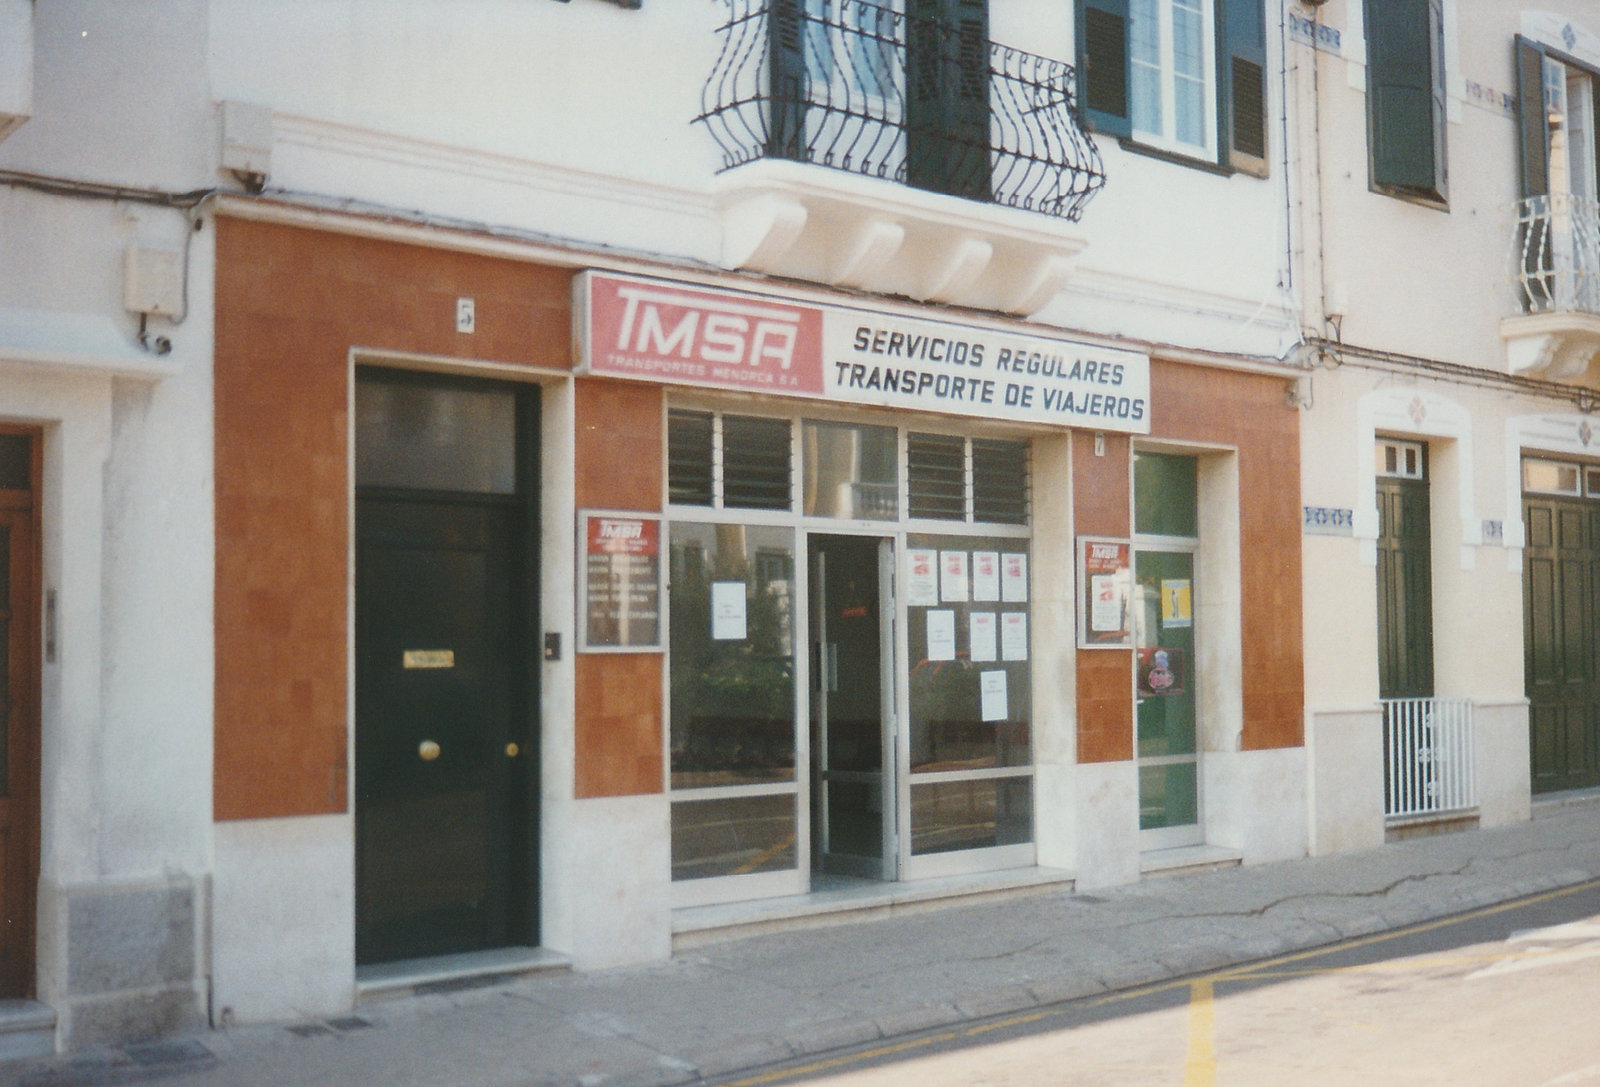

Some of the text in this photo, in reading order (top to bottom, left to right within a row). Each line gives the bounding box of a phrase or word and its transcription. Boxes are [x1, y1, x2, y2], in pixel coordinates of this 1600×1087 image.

[617, 287, 801, 370] TMSA
[853, 326, 1124, 386] SERVICIOS REGULARES
[607, 353, 705, 376] TRANSPORTES
[713, 367, 774, 384] MENORCA
[835, 361, 1146, 421] TRANSPORTE DE VIAJEROS
